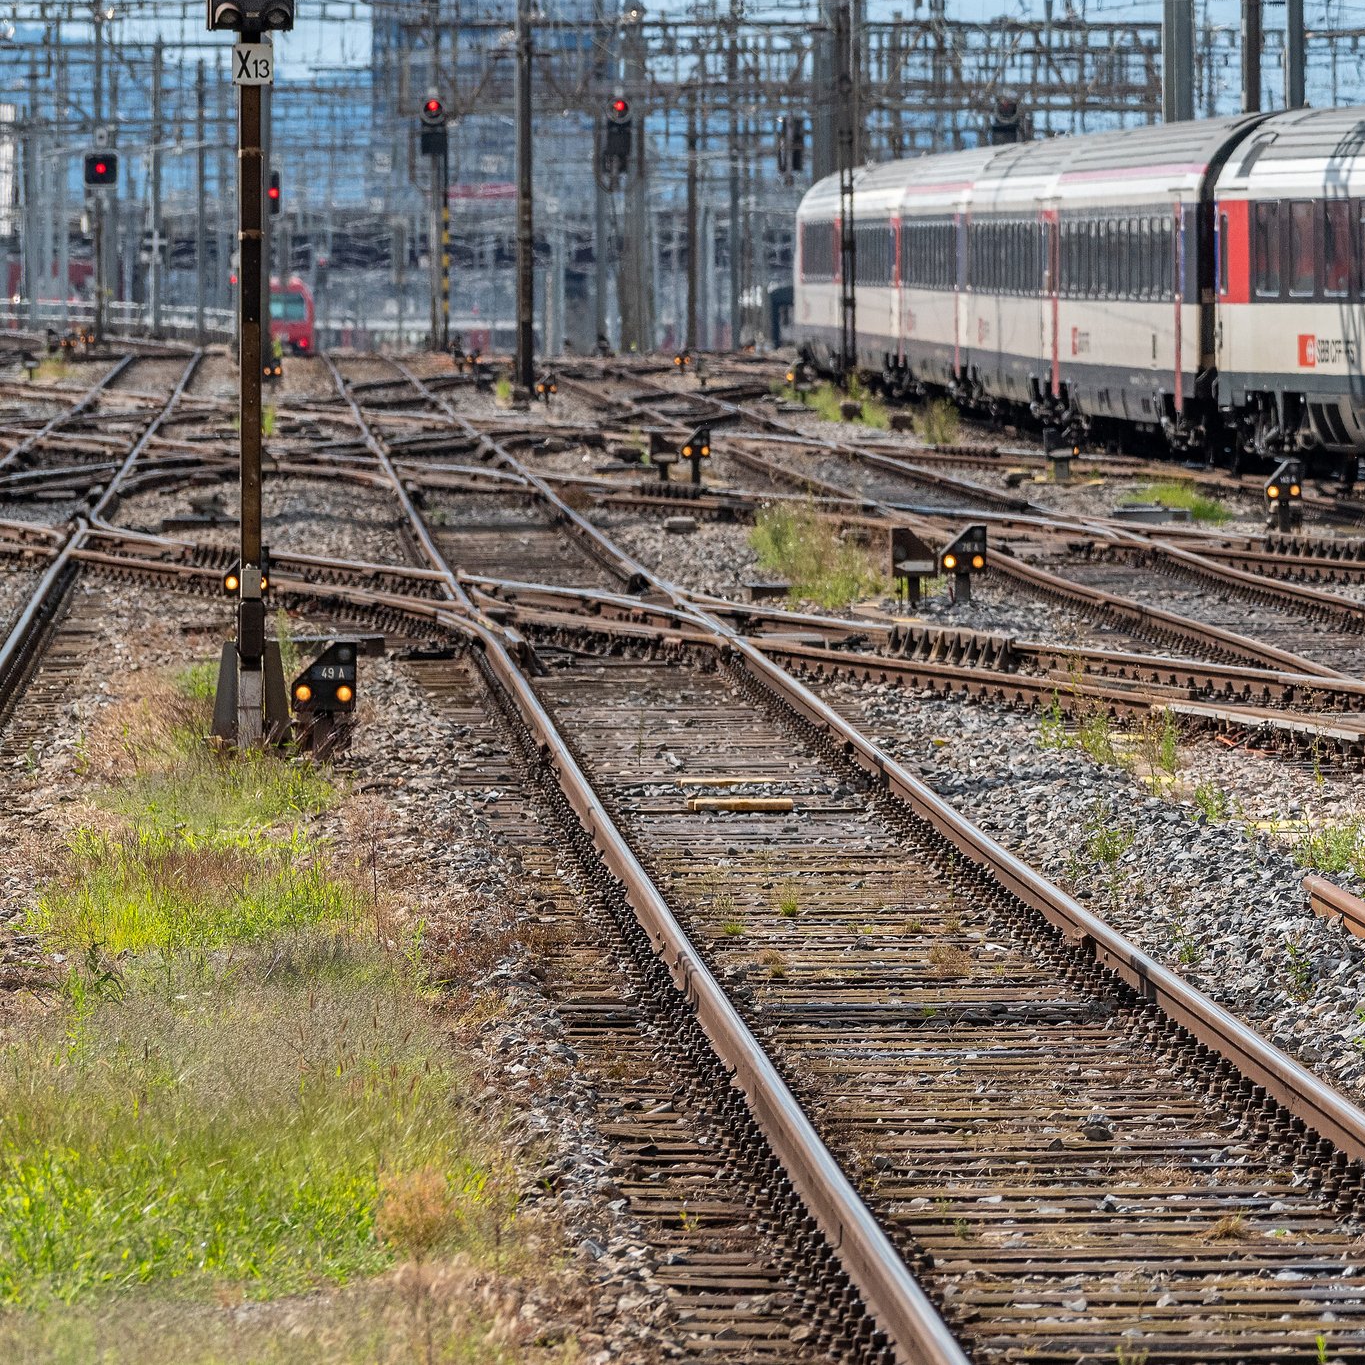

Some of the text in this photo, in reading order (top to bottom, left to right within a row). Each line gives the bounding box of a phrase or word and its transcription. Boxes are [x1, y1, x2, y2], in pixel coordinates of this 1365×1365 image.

[236, 49, 270, 79] X13
[1316, 339, 1329, 363] SBB
[321, 667, 345, 680] 49 A
